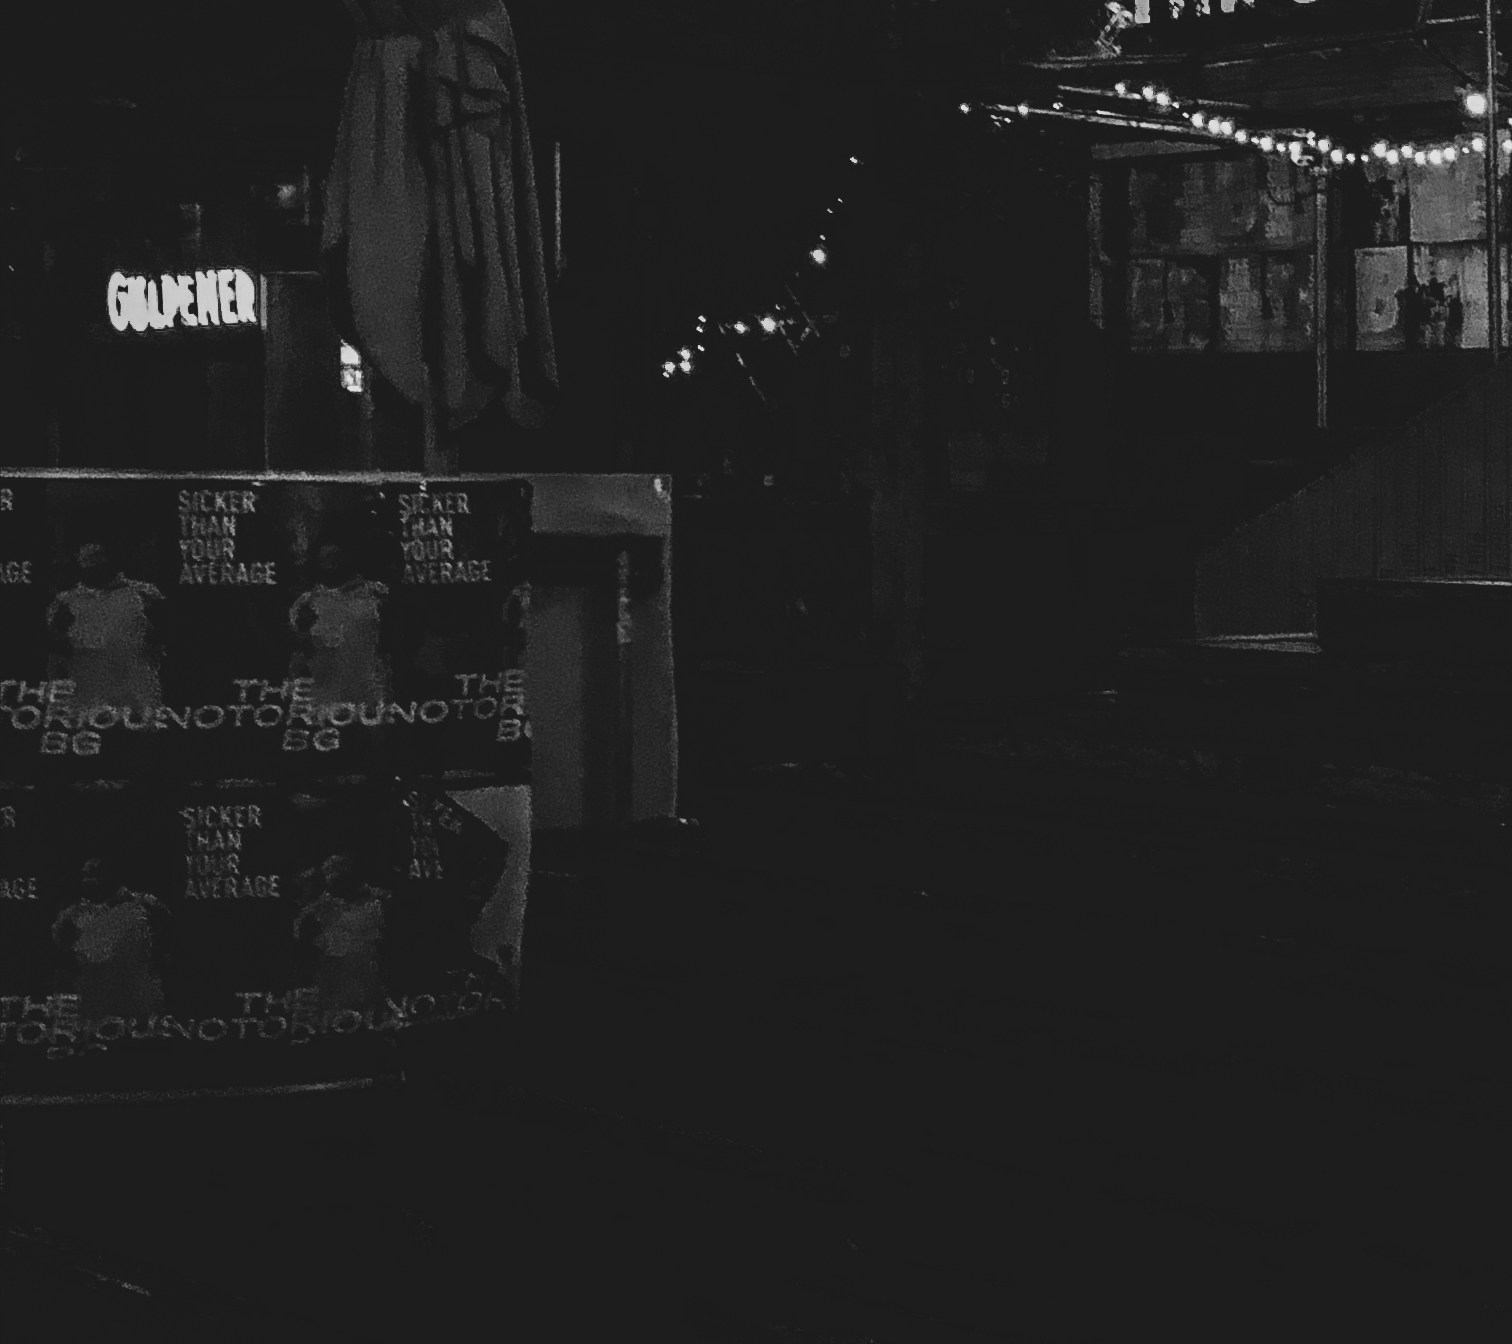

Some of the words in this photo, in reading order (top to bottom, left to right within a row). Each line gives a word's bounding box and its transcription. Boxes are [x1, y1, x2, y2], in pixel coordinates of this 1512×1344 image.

[178, 489, 255, 514] SICKER
[180, 515, 236, 537] THAN
[400, 514, 454, 538] THAN
[179, 538, 235, 561] YOUR
[401, 538, 454, 561] YOUR
[178, 561, 278, 585] AVERAGE
[402, 559, 492, 584] AVERAGE
[233, 676, 314, 703] THE
[454, 669, 526, 698] THE
[180, 804, 262, 829] SICKER
[183, 874, 281, 900] AVERAGE
